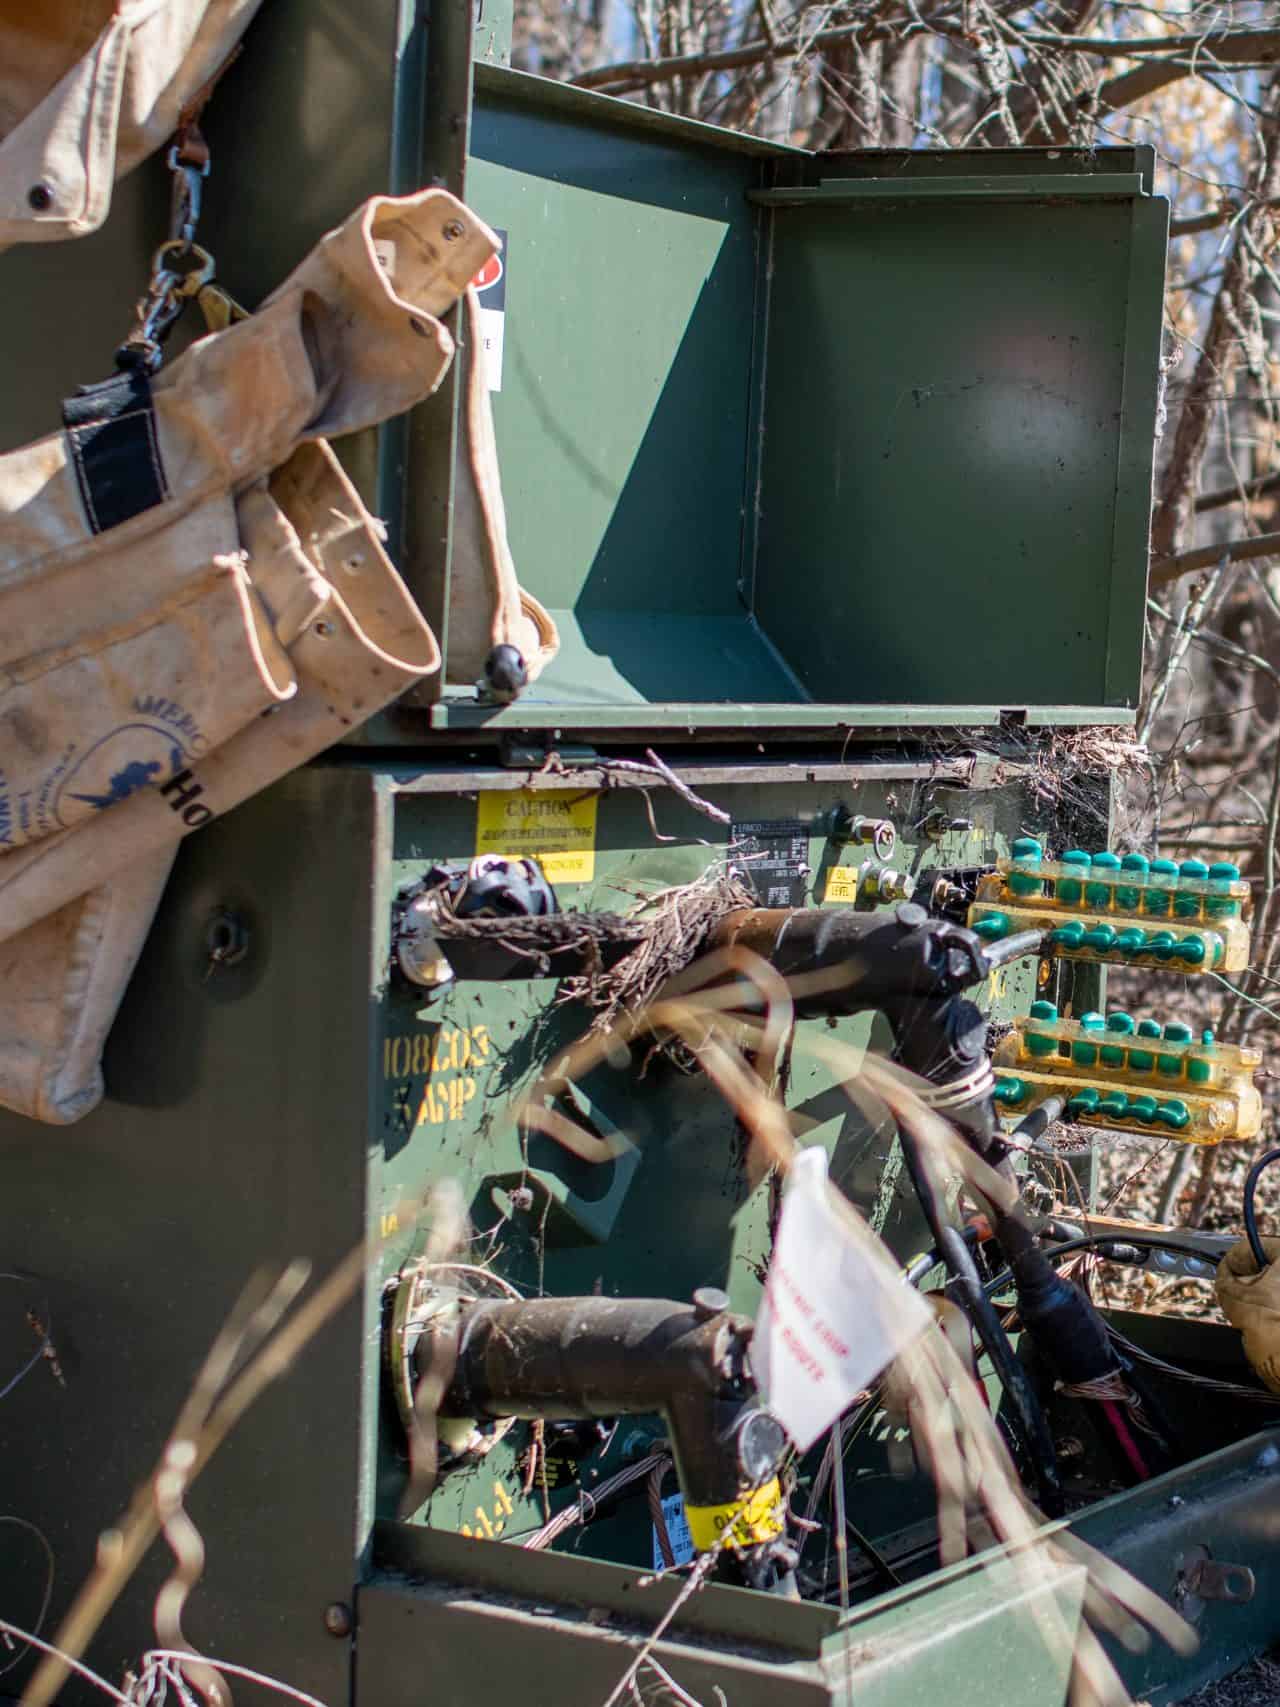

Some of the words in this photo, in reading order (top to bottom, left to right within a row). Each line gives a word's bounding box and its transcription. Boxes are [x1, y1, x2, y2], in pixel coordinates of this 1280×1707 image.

[505, 799, 571, 817] CAUTION
[831, 885, 850, 897] LEVEL
[416, 1076, 476, 1126] AMP
